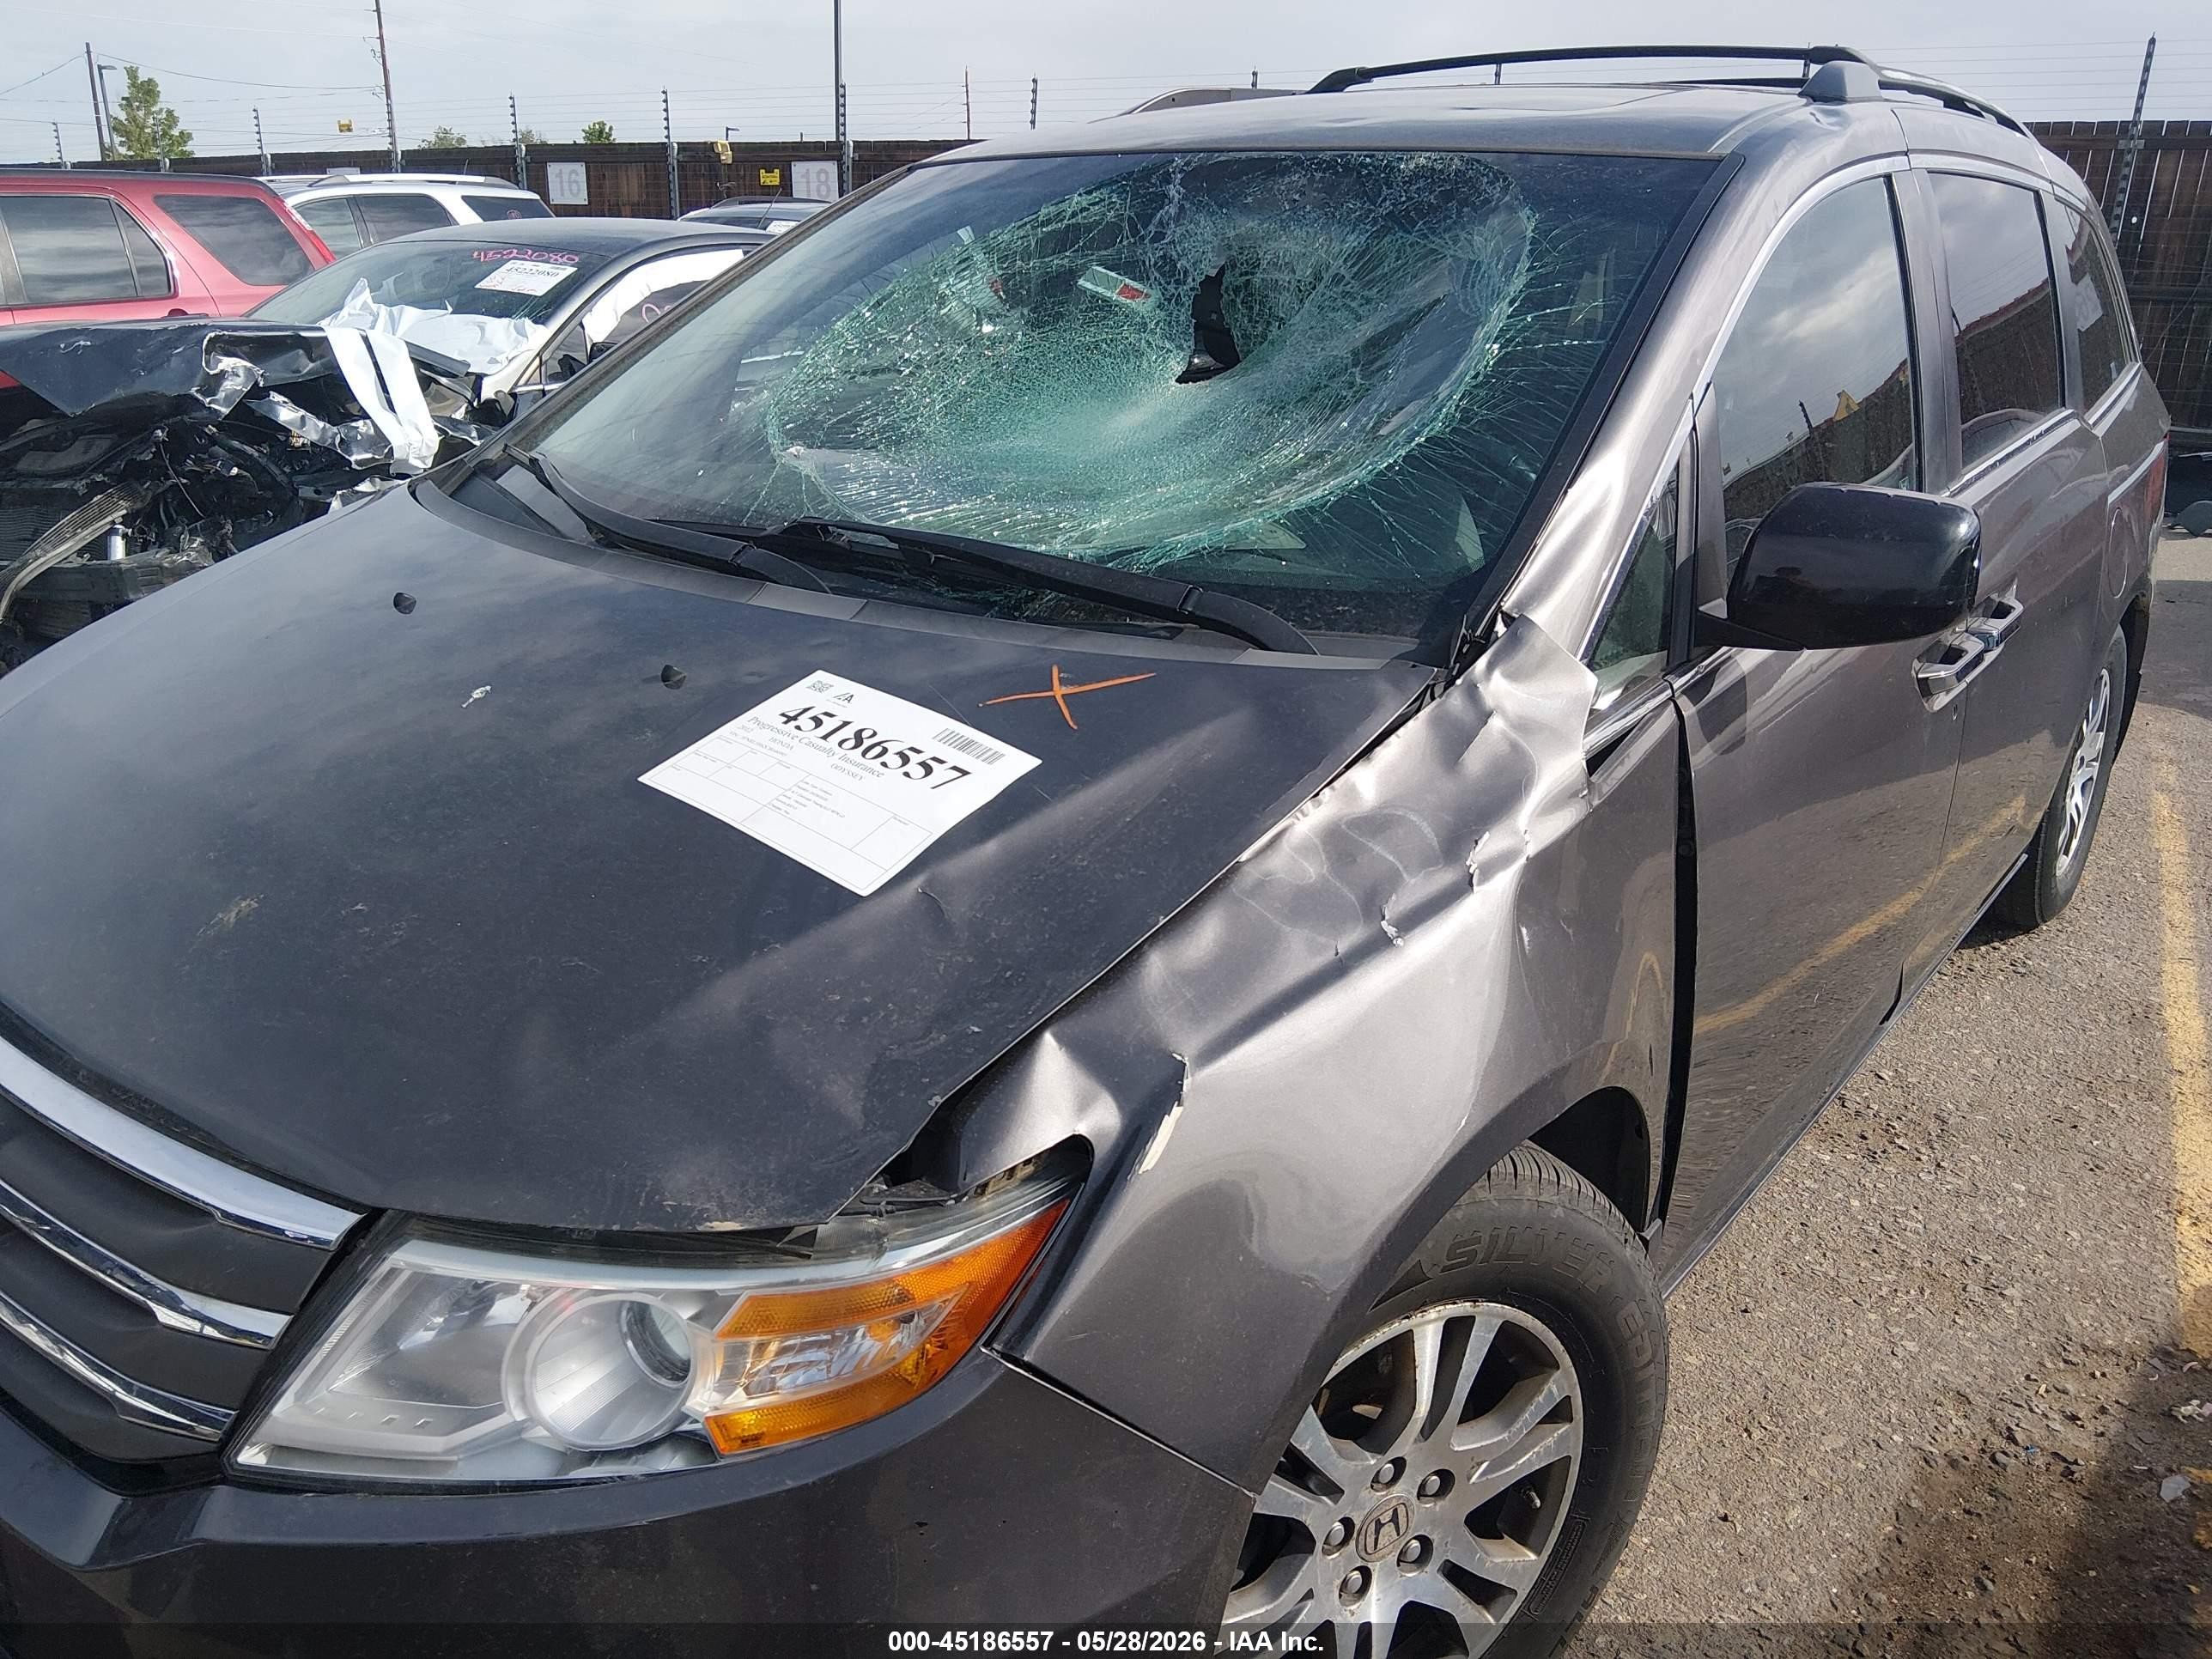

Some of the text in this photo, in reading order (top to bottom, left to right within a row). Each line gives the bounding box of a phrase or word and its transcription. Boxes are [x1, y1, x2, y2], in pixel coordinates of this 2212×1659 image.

[554, 167, 581, 199] 16
[800, 167, 831, 200] 18
[505, 266, 560, 277] 45222080
[747, 715, 799, 741] Progressive
[798, 735, 843, 763] Casualty
[837, 749, 887, 781] Insurance
[778, 705, 972, 790] 45186557
[1440, 1225, 1617, 1293] SILVER
